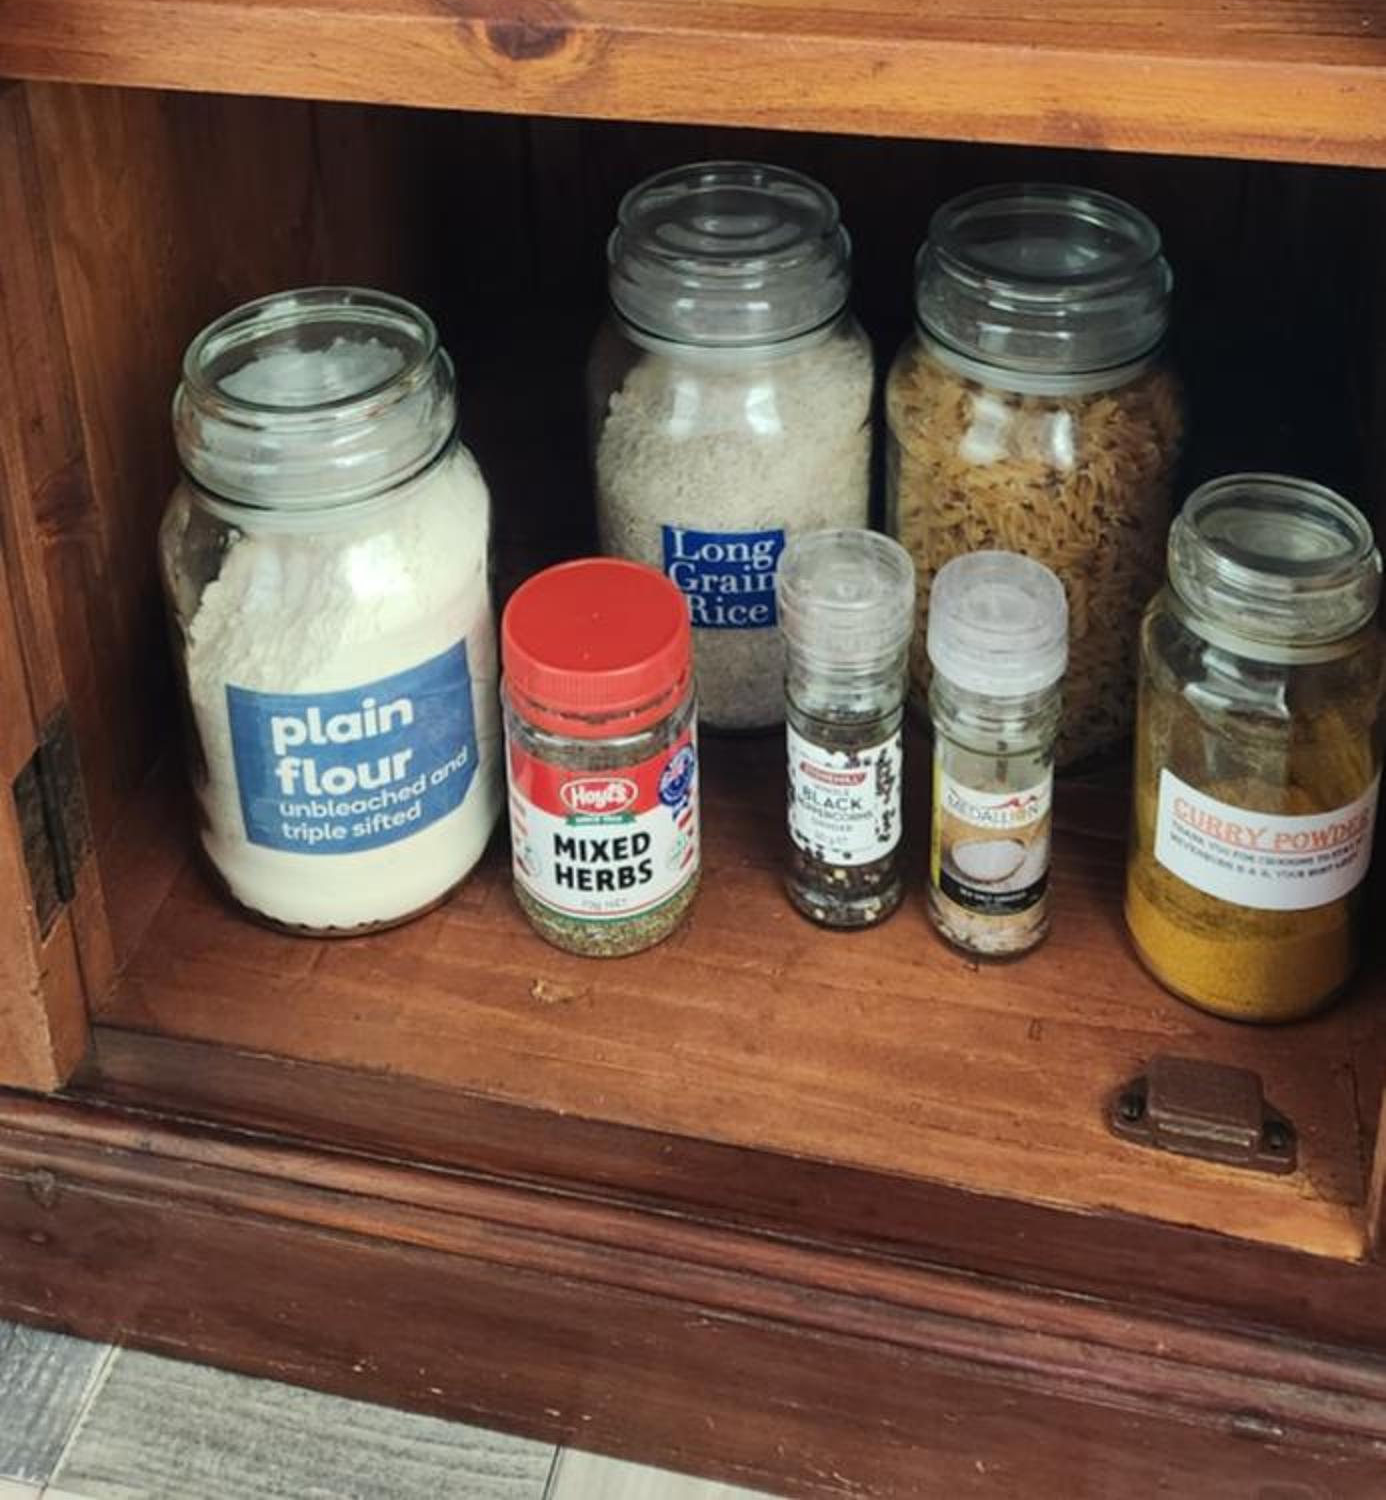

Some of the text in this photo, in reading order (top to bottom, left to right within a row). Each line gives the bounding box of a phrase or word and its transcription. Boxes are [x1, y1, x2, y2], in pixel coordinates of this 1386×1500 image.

[672, 530, 776, 571] Long
[687, 595, 770, 625] Rice
[271, 697, 414, 756] plain
[275, 748, 413, 796] flour
[279, 745, 469, 818] unbleached and
[802, 785, 862, 810] BLACK
[281, 801, 422, 845] triple sifted
[1173, 798, 1268, 847] CURRY
[1274, 807, 1369, 852] POWDER
[553, 831, 651, 863] MIXED
[554, 858, 653, 893] HERBS
